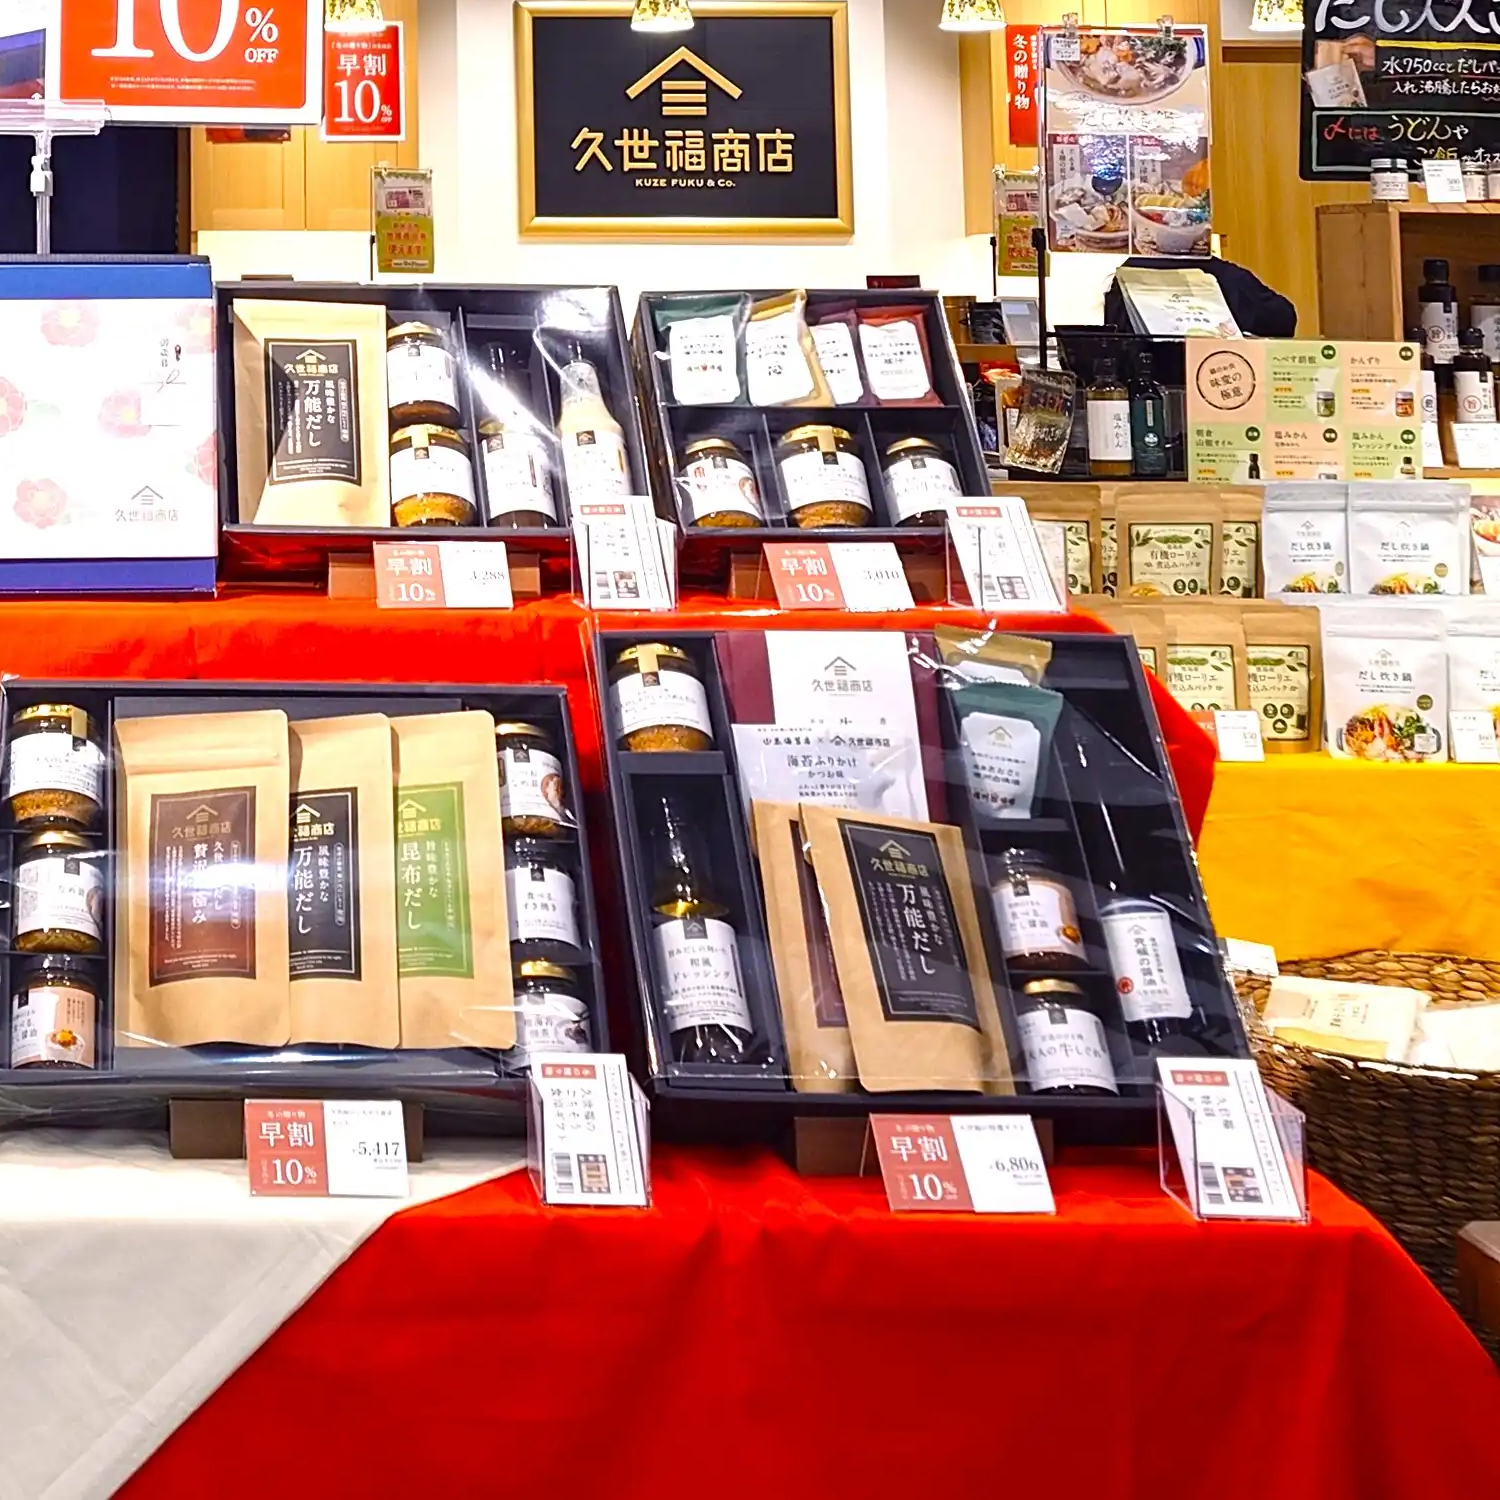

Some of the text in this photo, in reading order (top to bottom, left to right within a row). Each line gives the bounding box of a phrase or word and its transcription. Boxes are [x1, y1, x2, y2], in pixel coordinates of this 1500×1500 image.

[244, 48, 280, 65] OFF
[336, 53, 387, 78] 早割
[1013, 33, 1031, 111] 冬の贈り物
[569, 127, 796, 173] 久世福商店
[635, 178, 737, 188] KUZE FUKU & Co.
[303, 379, 323, 447] 万能だし
[1150, 550, 1199, 560] 有機ローリエ
[1290, 541, 1332, 552] だし炊き鍋
[385, 557, 433, 576] 早割
[780, 557, 828, 577] 早割
[811, 679, 873, 693] 久世福商店
[1358, 670, 1413, 682] だし炊き鍋
[787, 754, 858, 768] 海苔ふりかけ
[171, 820, 232, 839] 久世福商店
[293, 821, 336, 837] 福商店
[318, 845, 330, 903] 風味豊かな
[870, 856, 929, 878] 久世福商店
[293, 845, 315, 934] 万能だし
[401, 841, 423, 930] 昆布だし
[920, 886, 944, 947] 風味豊かな
[895, 883, 936, 975] 万能だし
[1133, 937, 1158, 987] 究極の醤油
[673, 969, 730, 982] ドレッシング
[259, 1121, 315, 1148] 早割
[890, 1135, 949, 1162] 早割
